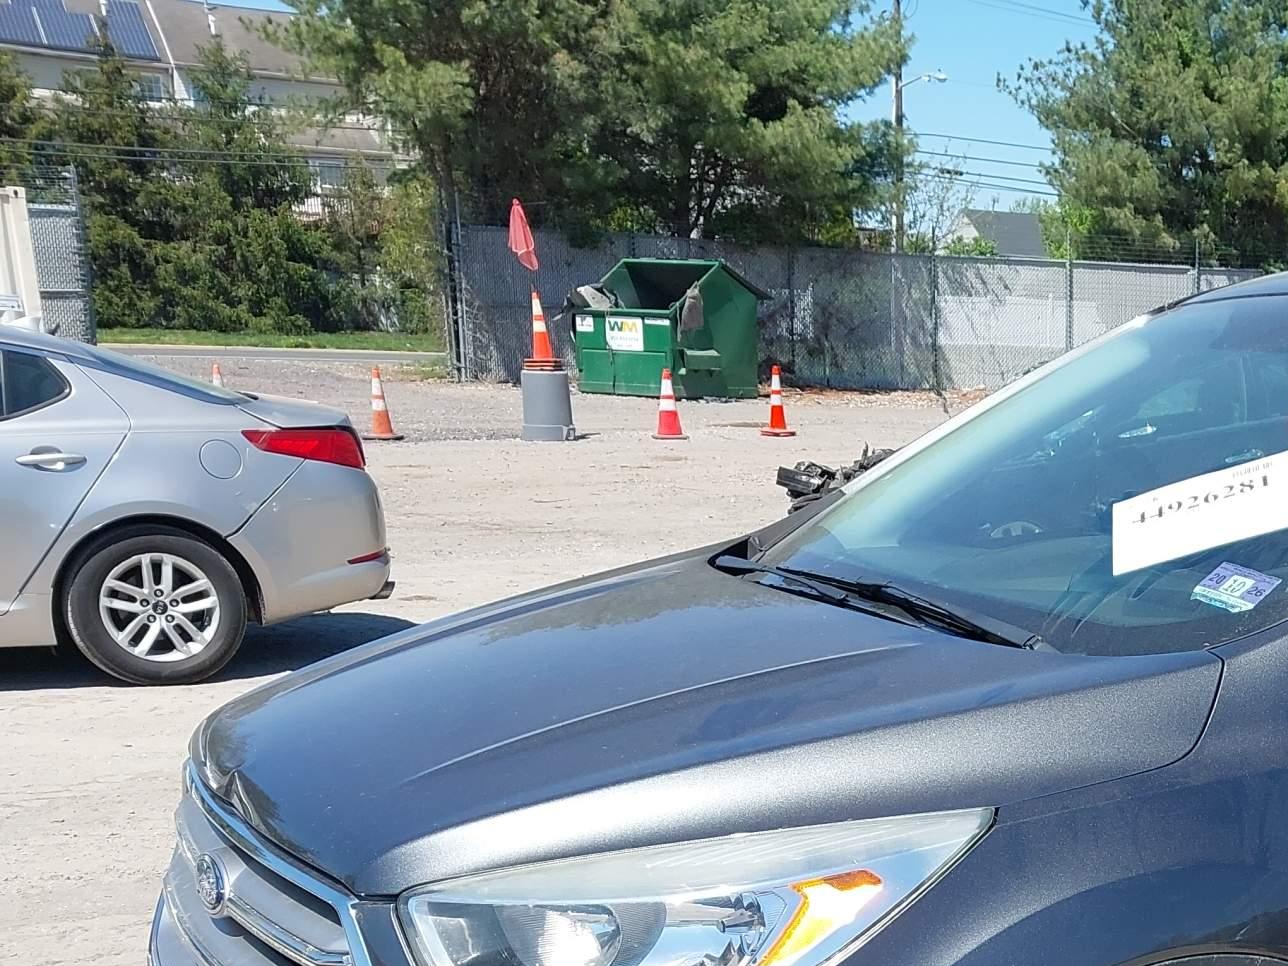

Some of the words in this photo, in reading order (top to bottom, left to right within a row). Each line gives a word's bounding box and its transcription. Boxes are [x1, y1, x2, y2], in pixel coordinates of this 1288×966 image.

[608, 320, 638, 333] WM
[1132, 475, 1268, 524] 44926281
[1208, 573, 1226, 585] 20
[1247, 586, 1266, 597] 26
